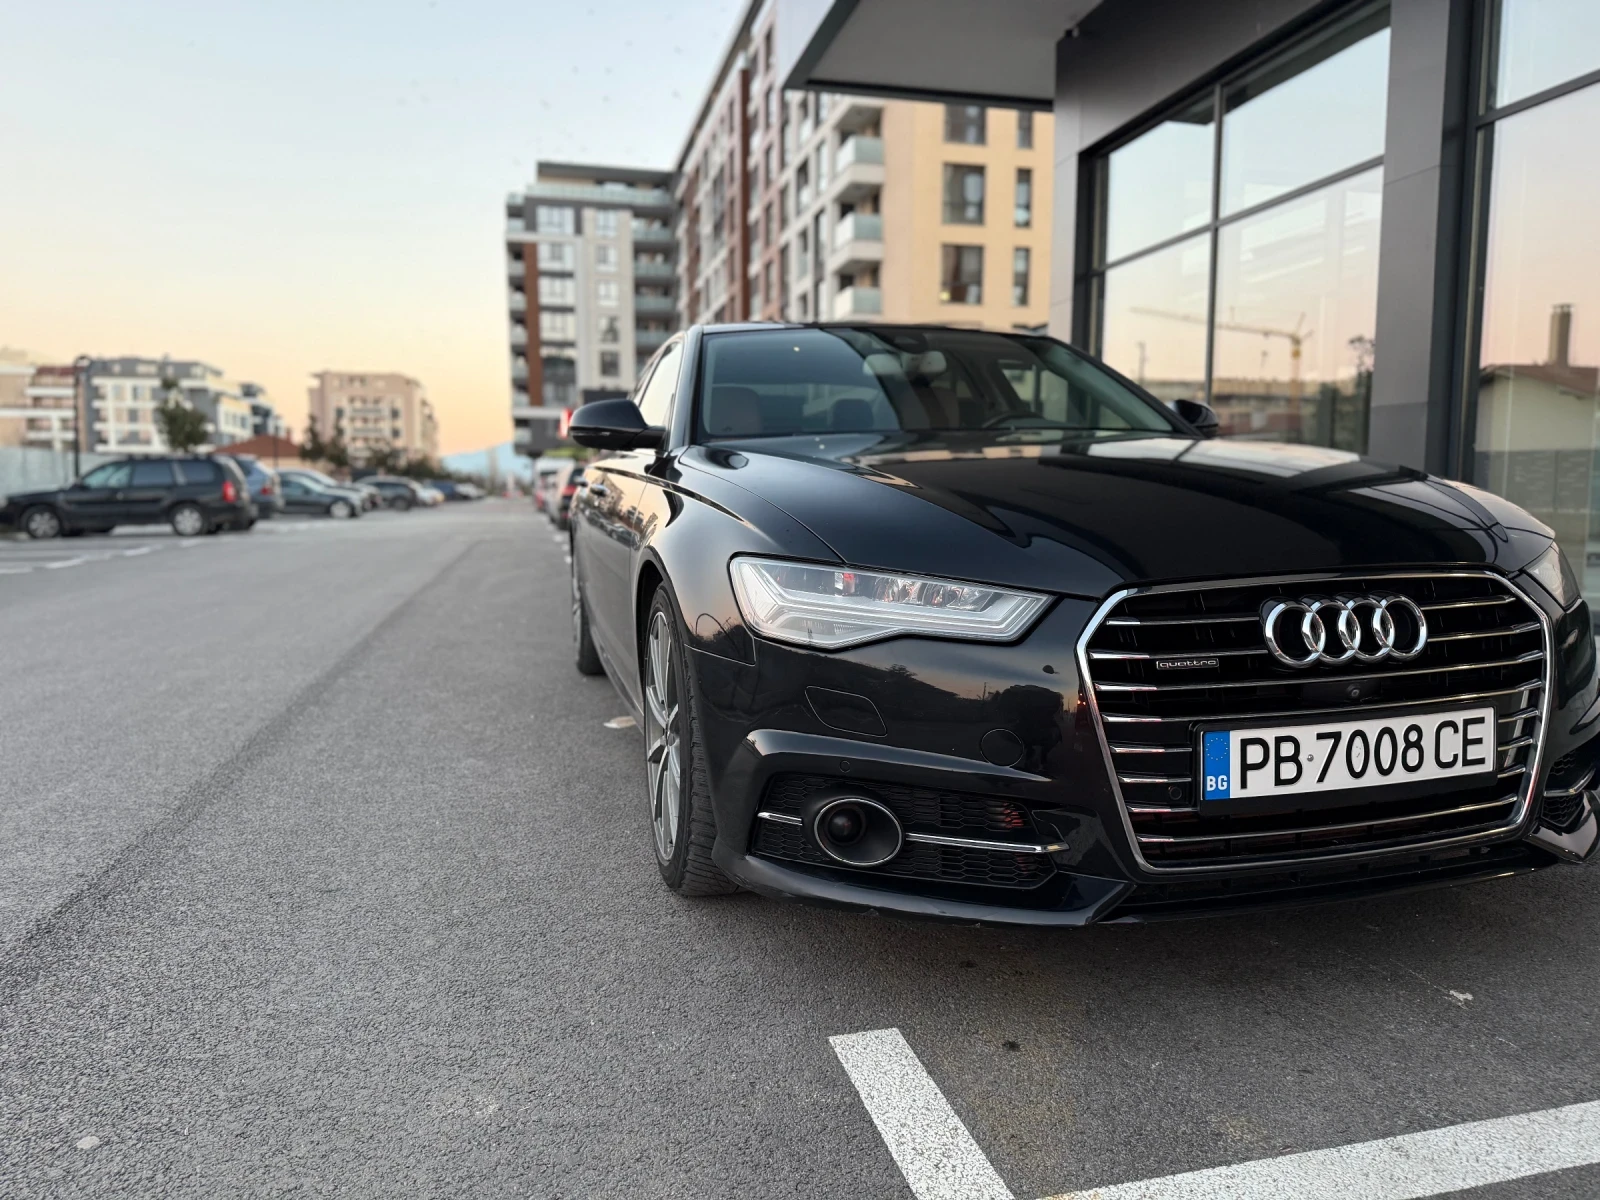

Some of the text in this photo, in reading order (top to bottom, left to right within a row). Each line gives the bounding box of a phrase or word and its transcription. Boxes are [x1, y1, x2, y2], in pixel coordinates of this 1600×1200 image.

[1159, 660, 1217, 669] quattro
[1240, 716, 1486, 790] PB 7008 CE
[1206, 775, 1228, 792] BG
